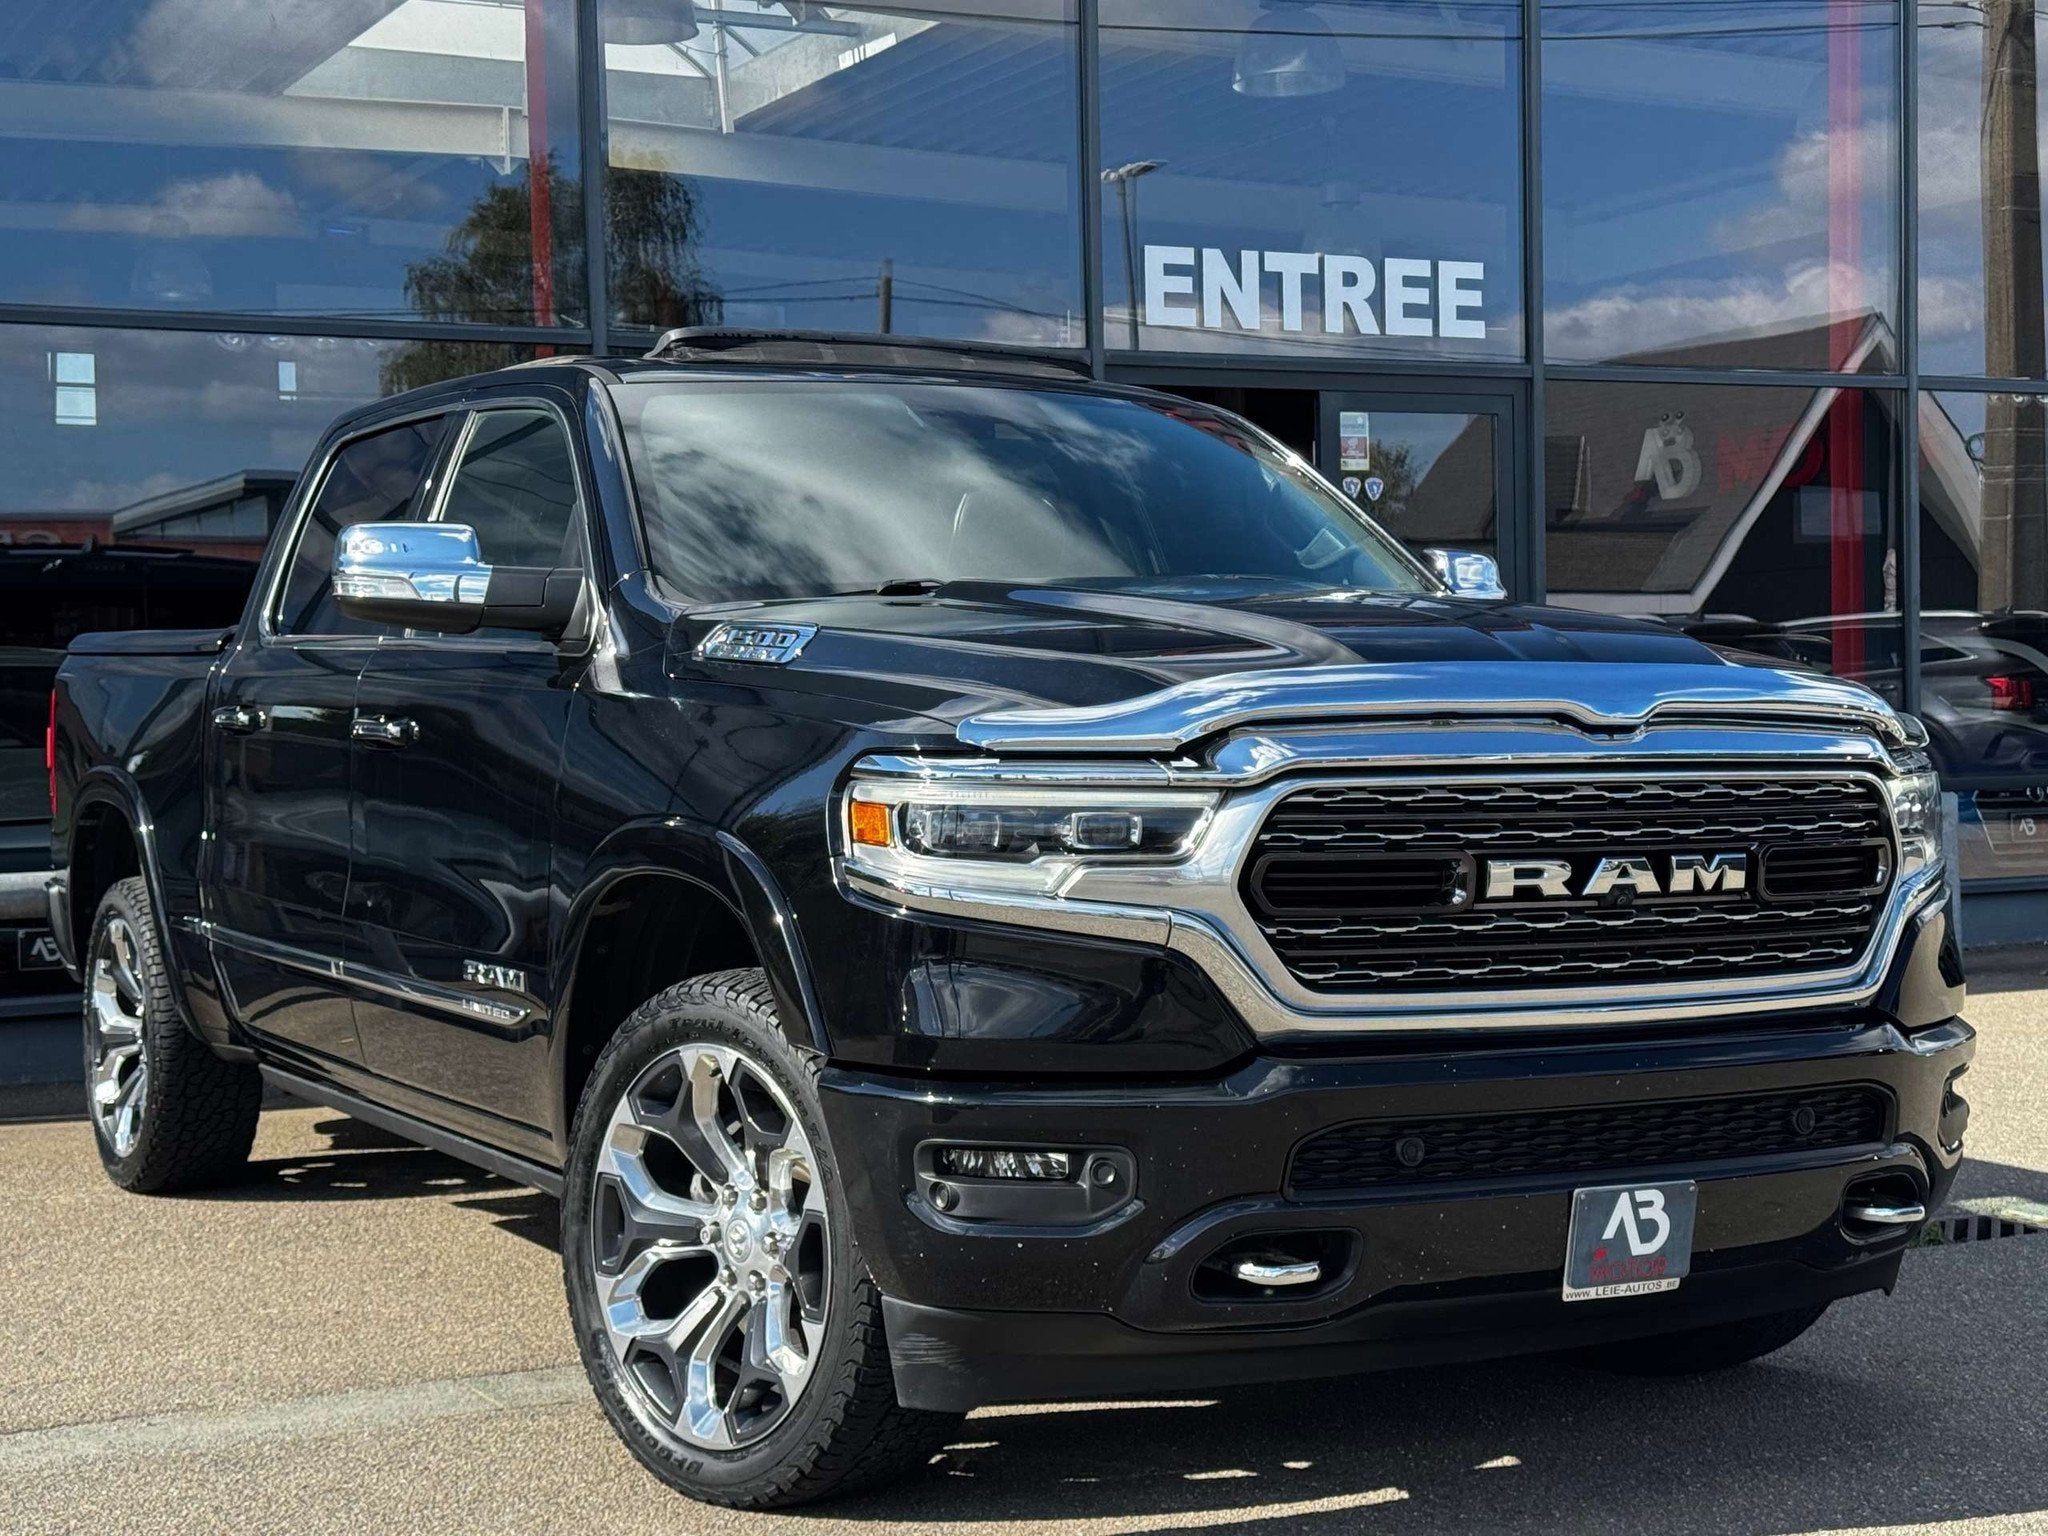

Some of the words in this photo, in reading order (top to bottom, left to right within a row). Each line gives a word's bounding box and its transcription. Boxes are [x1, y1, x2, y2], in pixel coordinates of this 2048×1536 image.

[1144, 245, 1486, 339] ENTREE
[1486, 853, 1746, 898] RAM
[463, 959, 525, 993] RAM
[1589, 1256, 1669, 1283] MOTOR
[1595, 1280, 1662, 1297] LEIE-AUTOS
